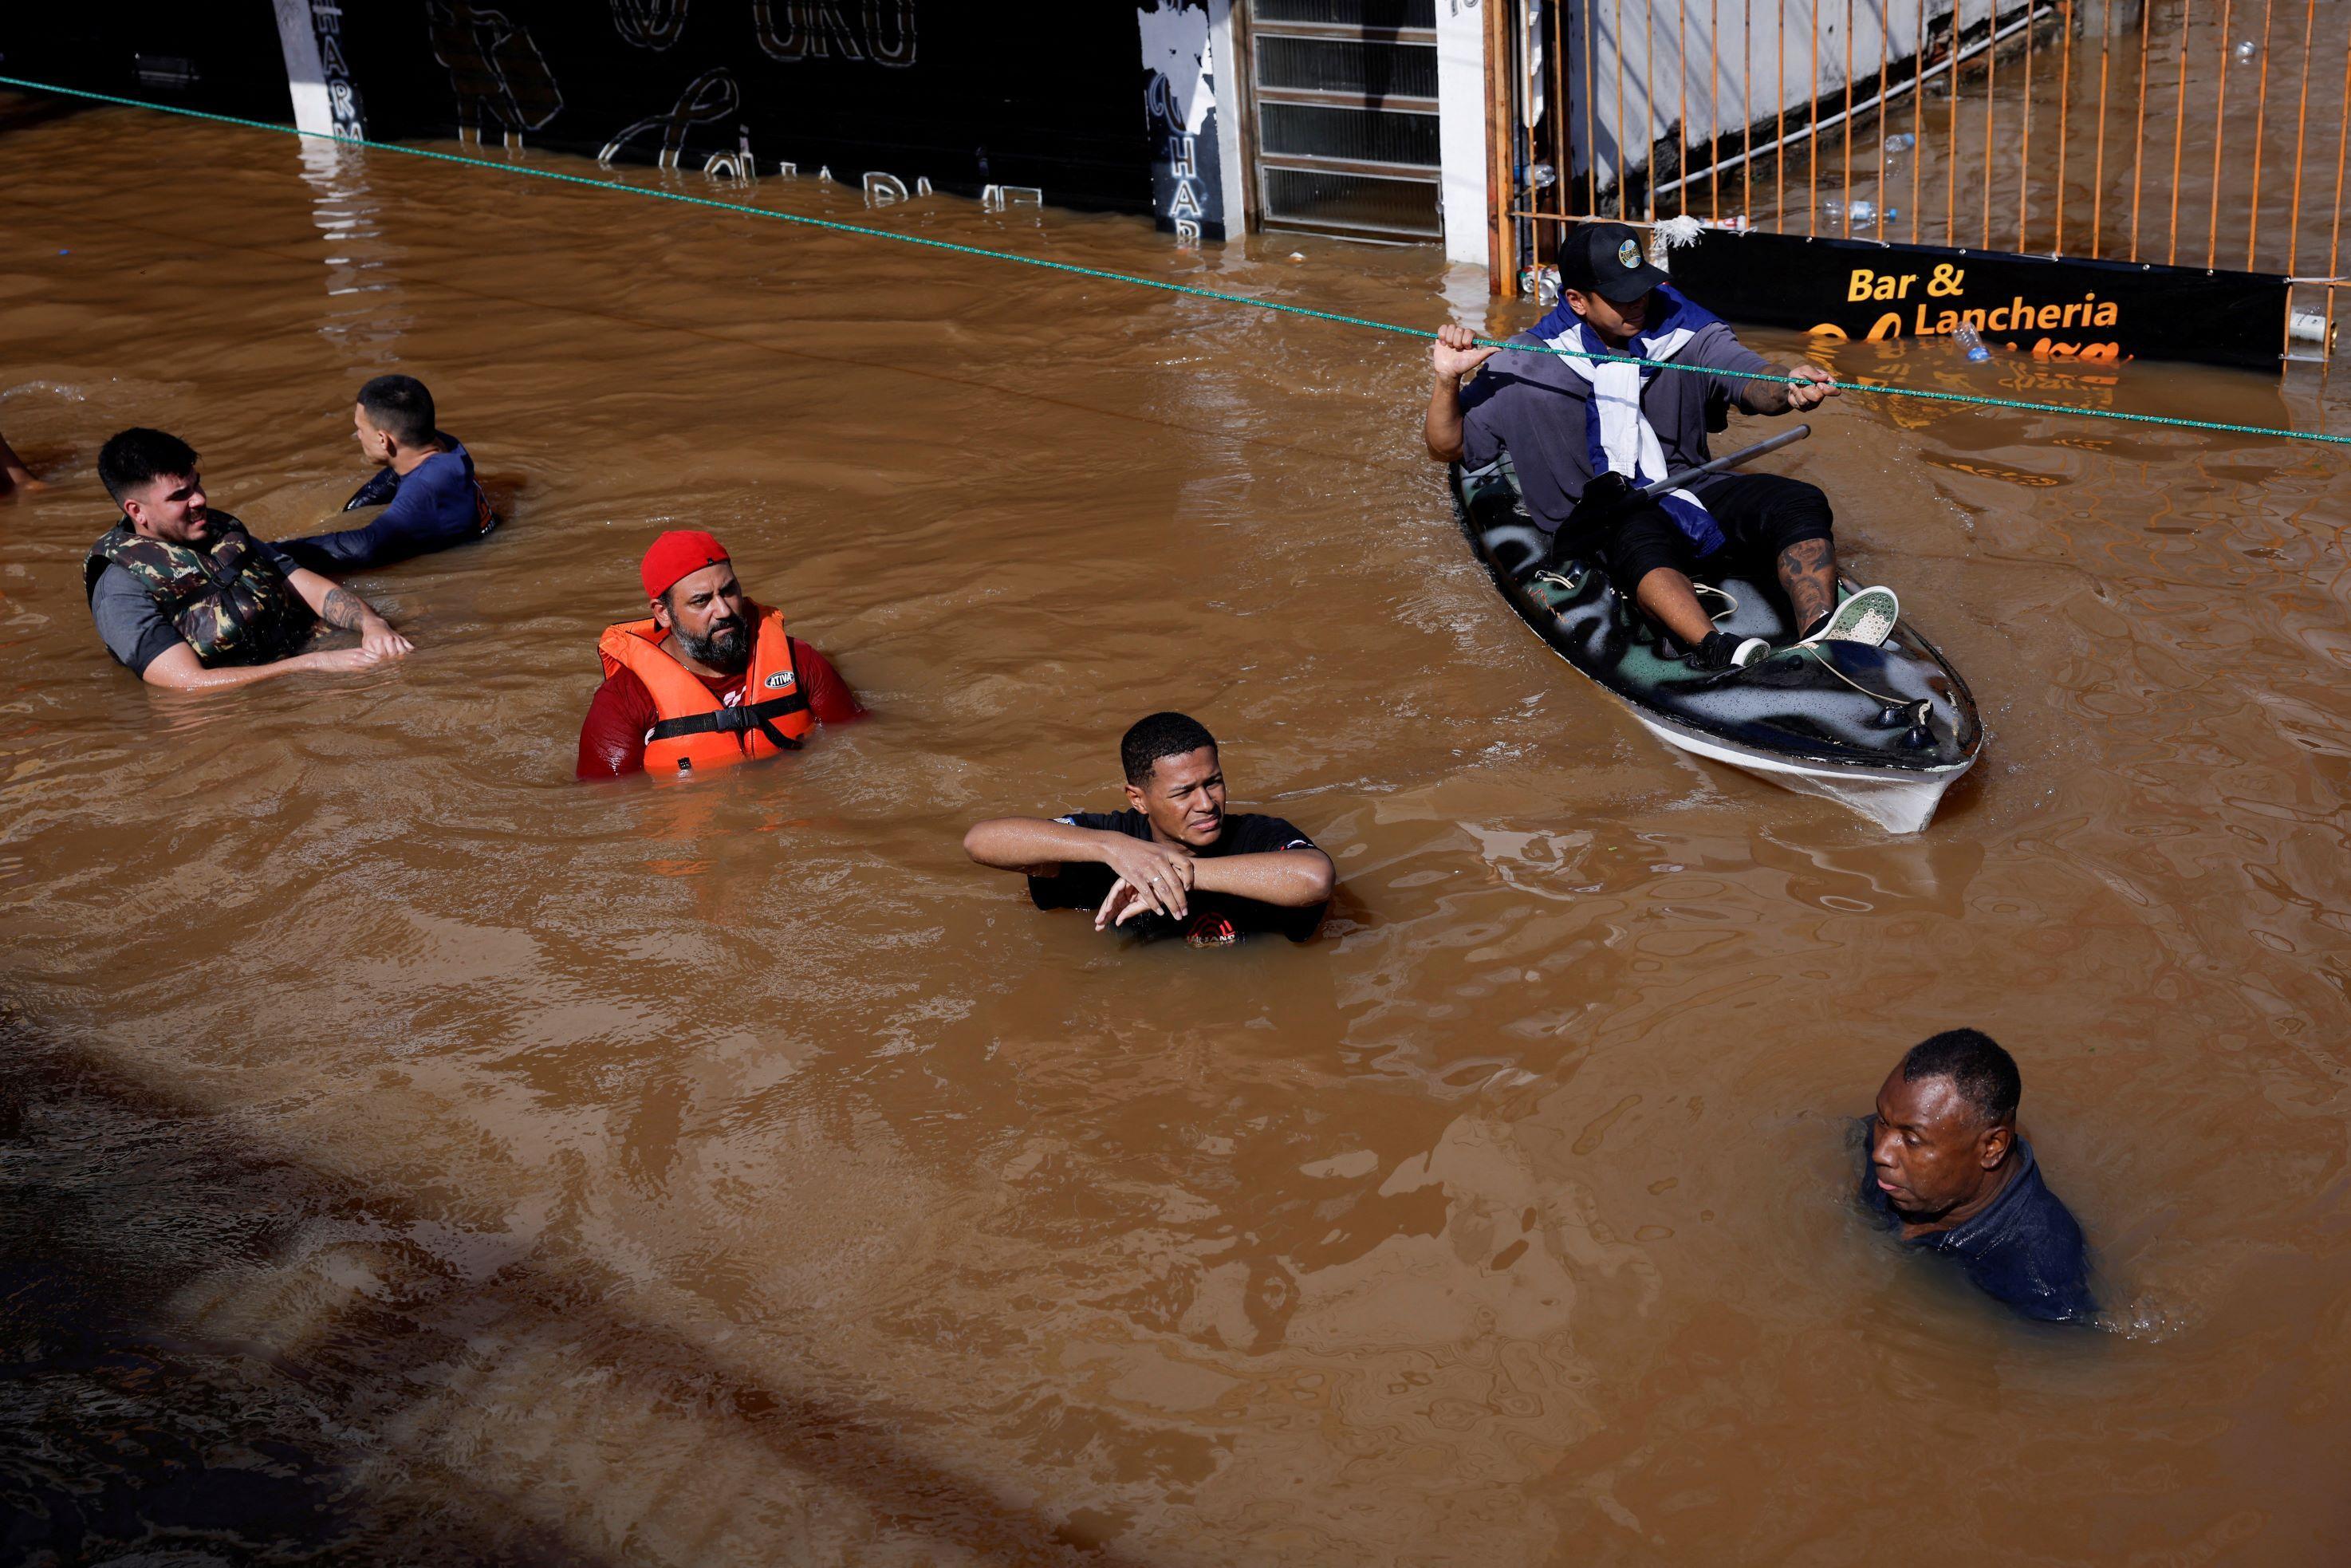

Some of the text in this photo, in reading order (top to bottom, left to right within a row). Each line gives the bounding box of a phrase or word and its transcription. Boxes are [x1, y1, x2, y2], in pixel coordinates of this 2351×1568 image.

[1847, 262, 1965, 302] Bar &
[1914, 292, 2119, 336] Lancheria
[770, 672, 792, 687] ATIVA
